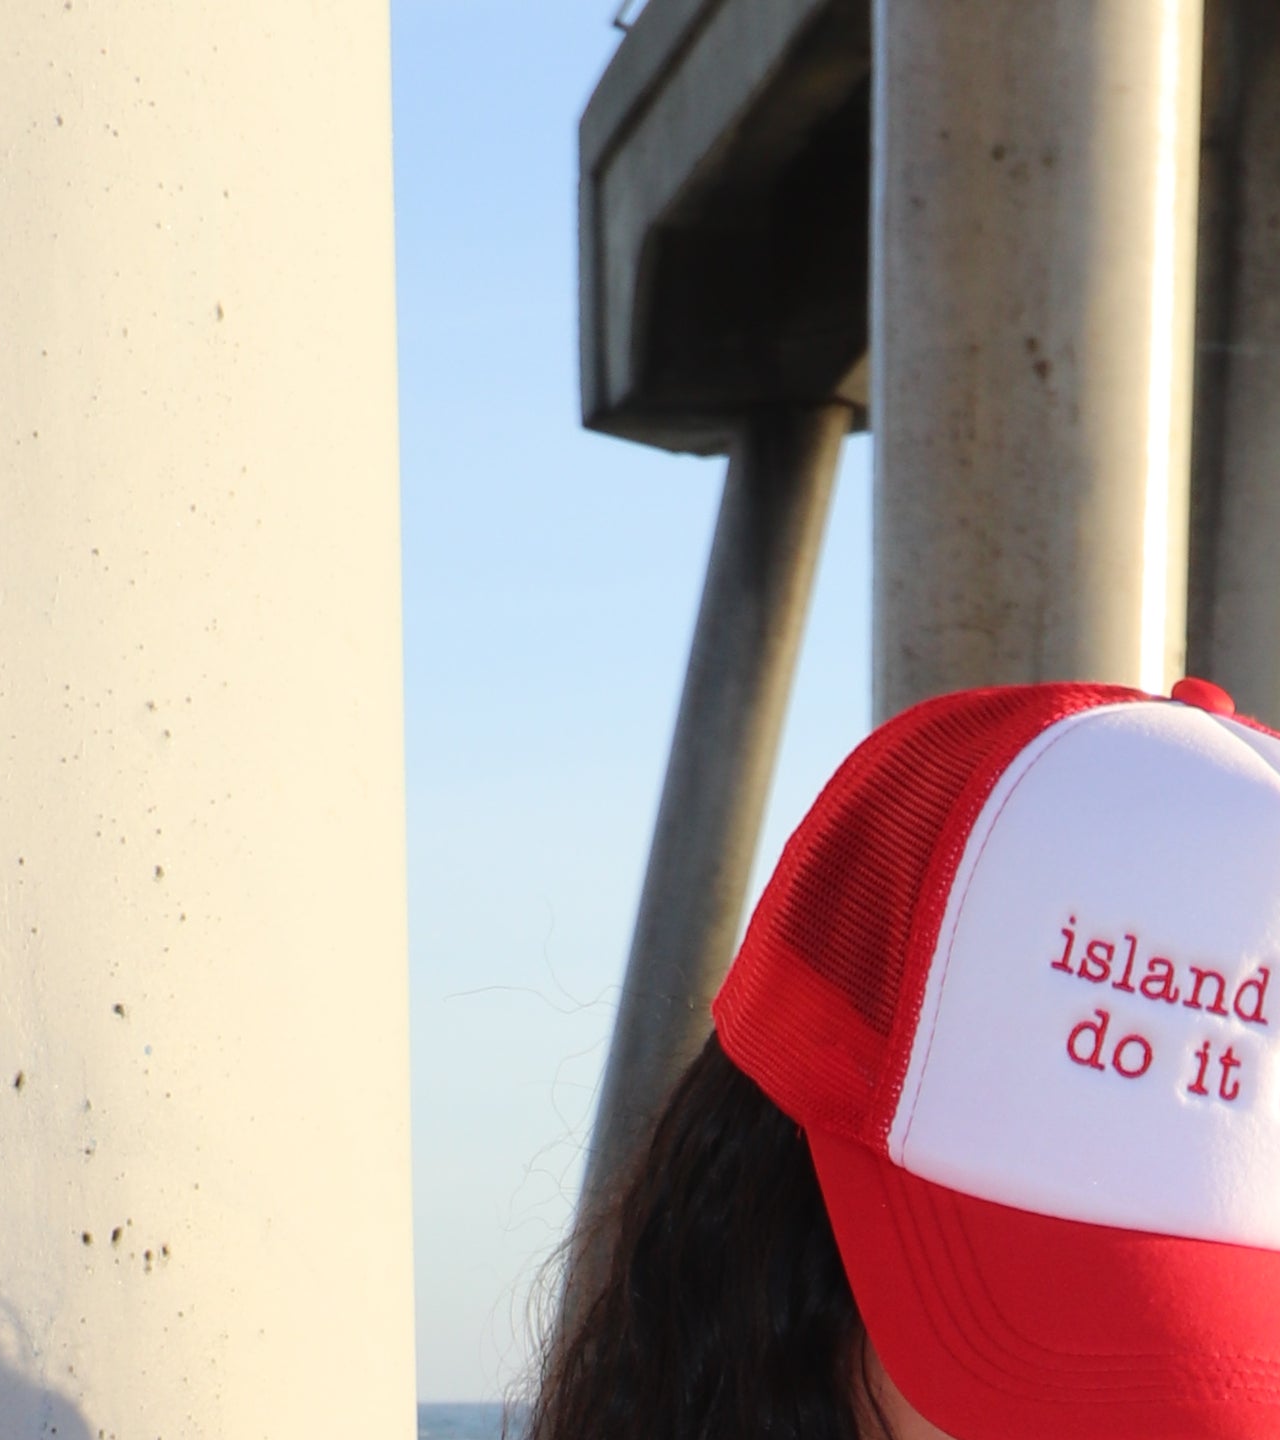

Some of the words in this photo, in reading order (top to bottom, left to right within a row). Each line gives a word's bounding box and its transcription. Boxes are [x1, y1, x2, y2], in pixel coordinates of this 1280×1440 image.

[1051, 915, 1270, 1026] island
[1066, 1008, 1153, 1079] do
[1186, 1040, 1242, 1102] it
